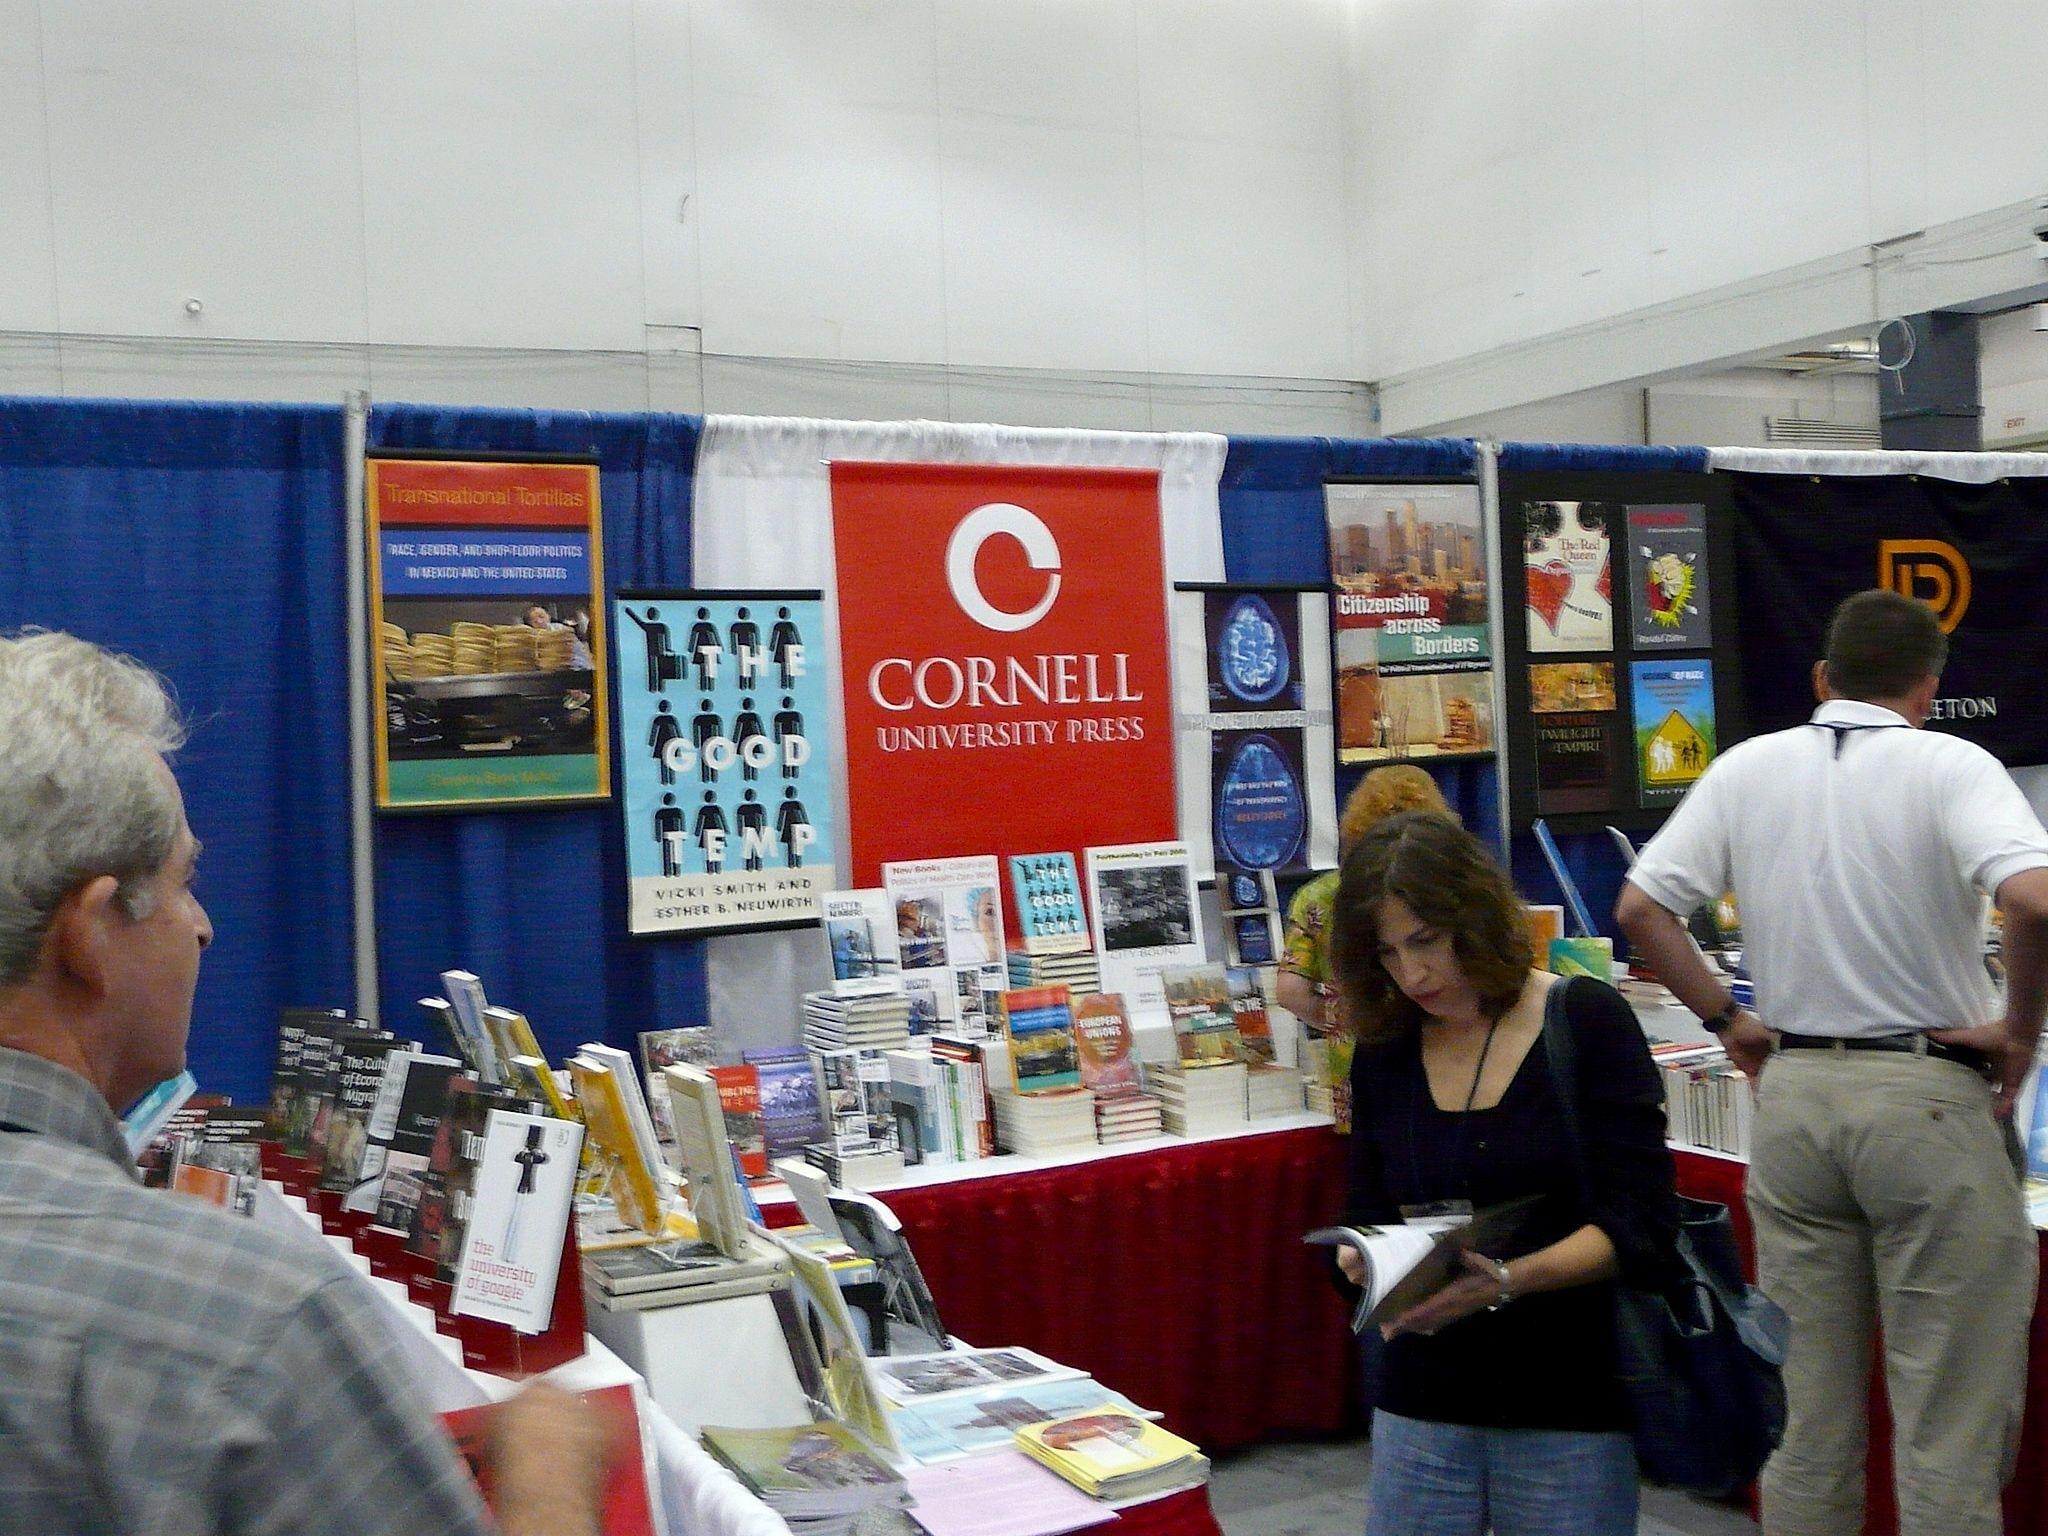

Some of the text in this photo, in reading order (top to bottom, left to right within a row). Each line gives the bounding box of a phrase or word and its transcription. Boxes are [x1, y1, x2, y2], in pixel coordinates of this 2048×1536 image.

[2003, 417, 2026, 429] EXIT
[383, 483, 584, 508] Transnational Tortillas
[543, 544, 583, 558] POLITICS
[421, 567, 459, 580] MEXICO
[535, 567, 568, 580] STATES
[1339, 593, 1430, 616] Citizenship
[1384, 617, 1442, 635] across
[1413, 635, 1480, 656] Borders
[698, 644, 807, 679] THE
[868, 653, 1144, 711] CORNELL
[1922, 697, 1998, 720] ETON
[876, 716, 1145, 752] UNIVERSITY PRESS
[662, 734, 811, 773] GOOD
[663, 823, 817, 865] TEMP
[656, 878, 812, 900] VICKI SMITH AND
[656, 897, 814, 920] ESTHER B. NEUWIRTH
[345, 1089, 379, 1106] Migrat
[473, 1239, 495, 1256] the
[469, 1259, 538, 1288] university
[467, 1275, 525, 1302] of google
